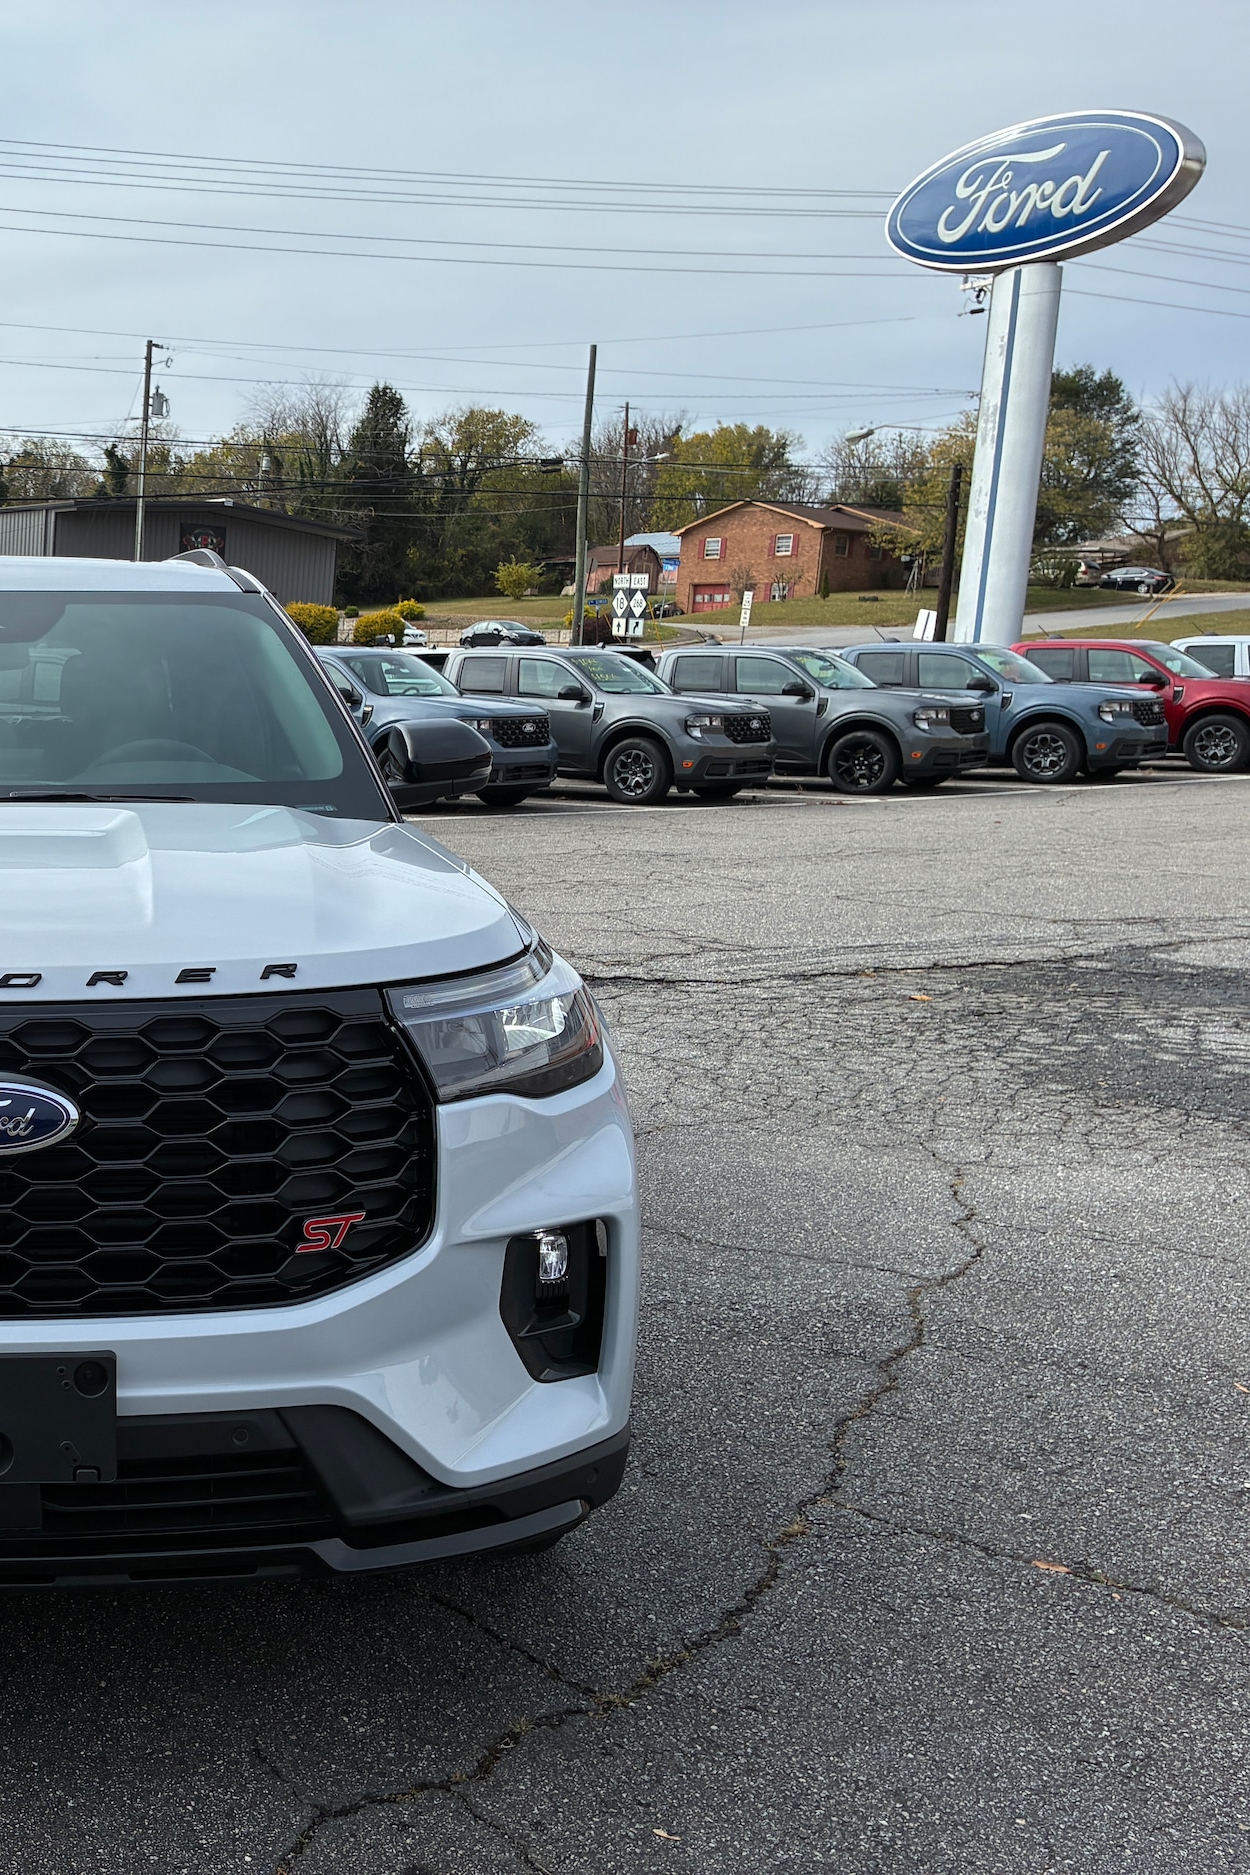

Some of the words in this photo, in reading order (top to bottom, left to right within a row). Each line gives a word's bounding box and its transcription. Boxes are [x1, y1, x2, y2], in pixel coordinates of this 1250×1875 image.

[937, 143, 1111, 243] Ford
[614, 577, 629, 585] NORTH
[633, 577, 646, 585] EAST
[616, 597, 625, 609] 18
[632, 598, 643, 608] 268
[295, 1211, 366, 1253] ST
